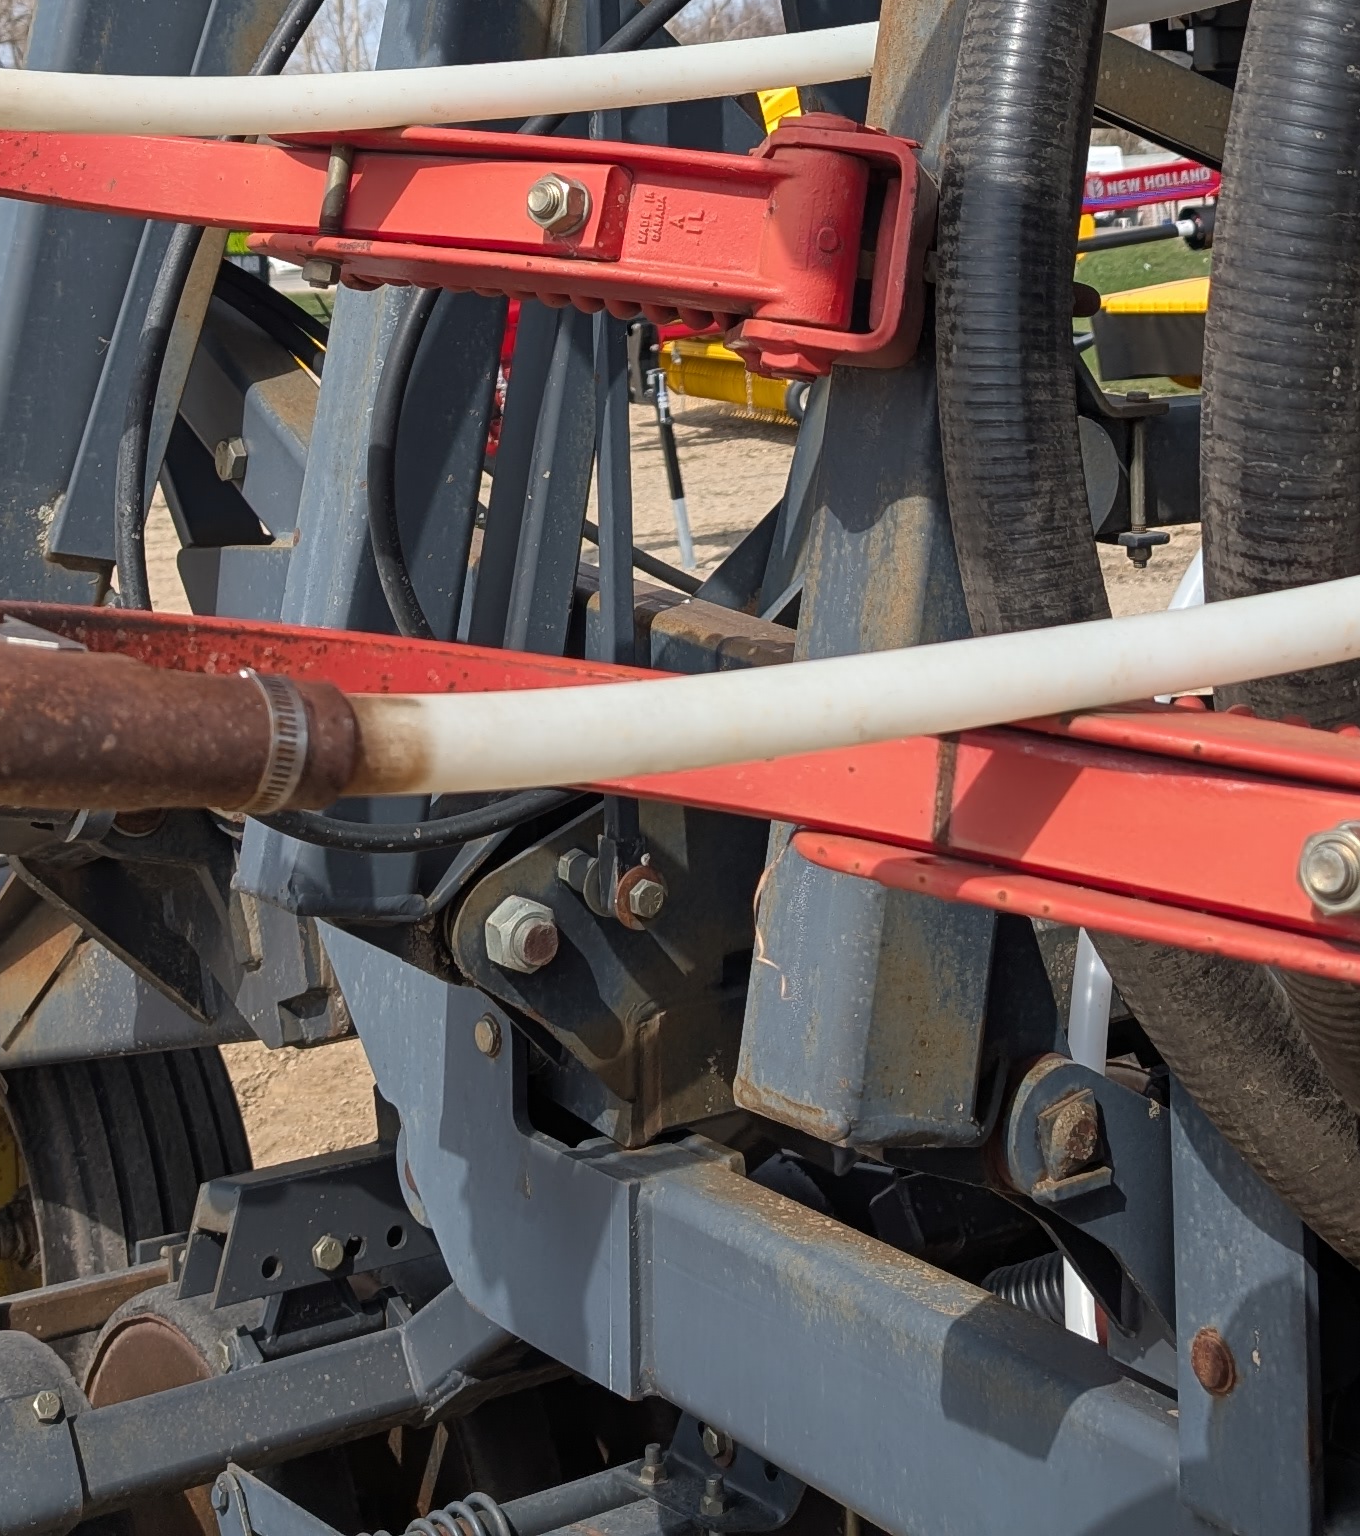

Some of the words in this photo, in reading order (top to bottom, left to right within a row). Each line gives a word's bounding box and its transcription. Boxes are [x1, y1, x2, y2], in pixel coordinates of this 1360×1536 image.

[1107, 176, 1140, 196] NEW
[1144, 166, 1212, 190] HOLLAND
[669, 215, 686, 230] A
